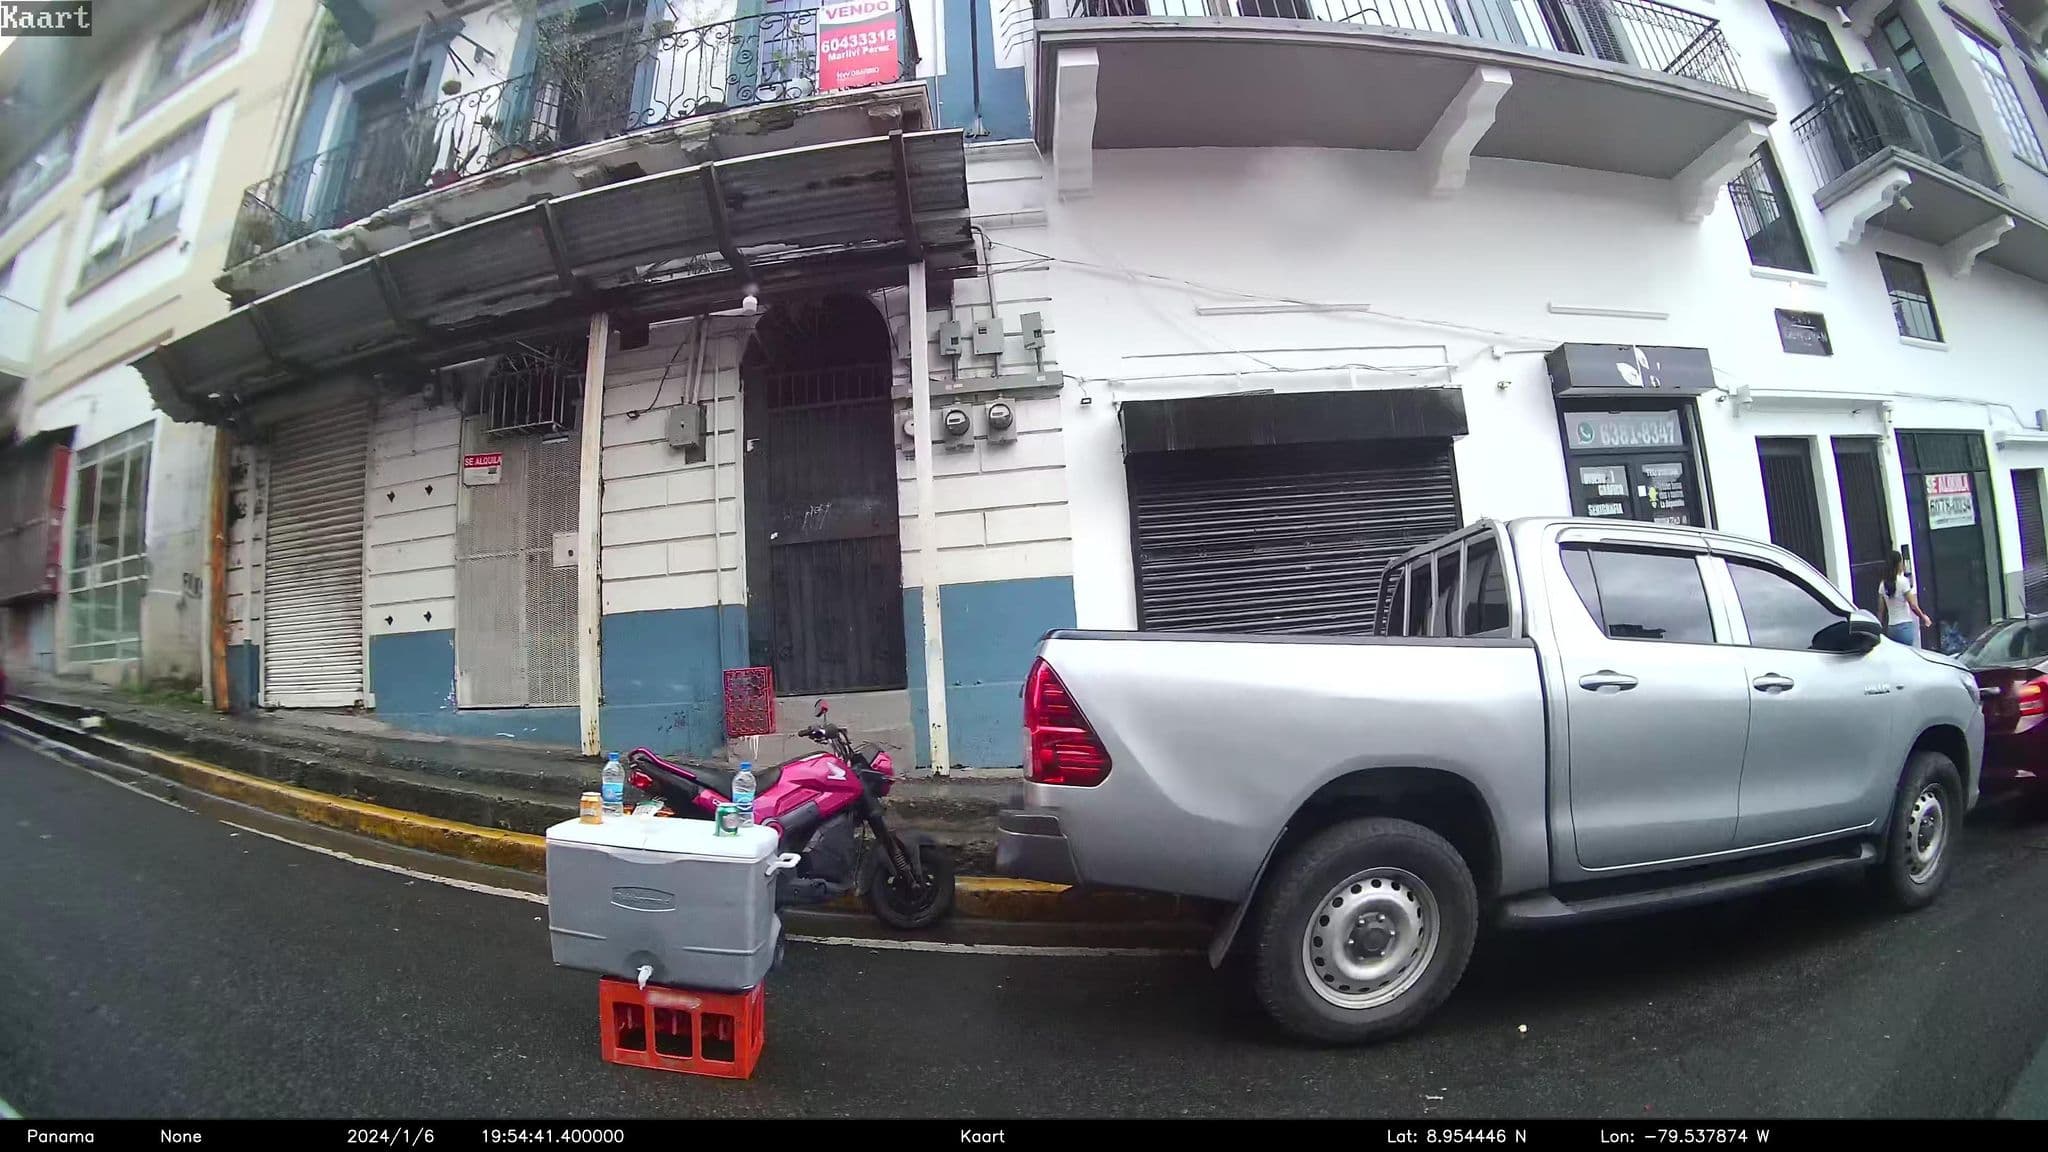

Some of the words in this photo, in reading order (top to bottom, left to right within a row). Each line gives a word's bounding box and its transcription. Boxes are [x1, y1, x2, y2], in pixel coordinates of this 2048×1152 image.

[826, 1, 889, 20] VENDO
[821, 29, 897, 53] 60433318
[464, 457, 474, 466] SE
[475, 455, 502, 466] ALQUILA
